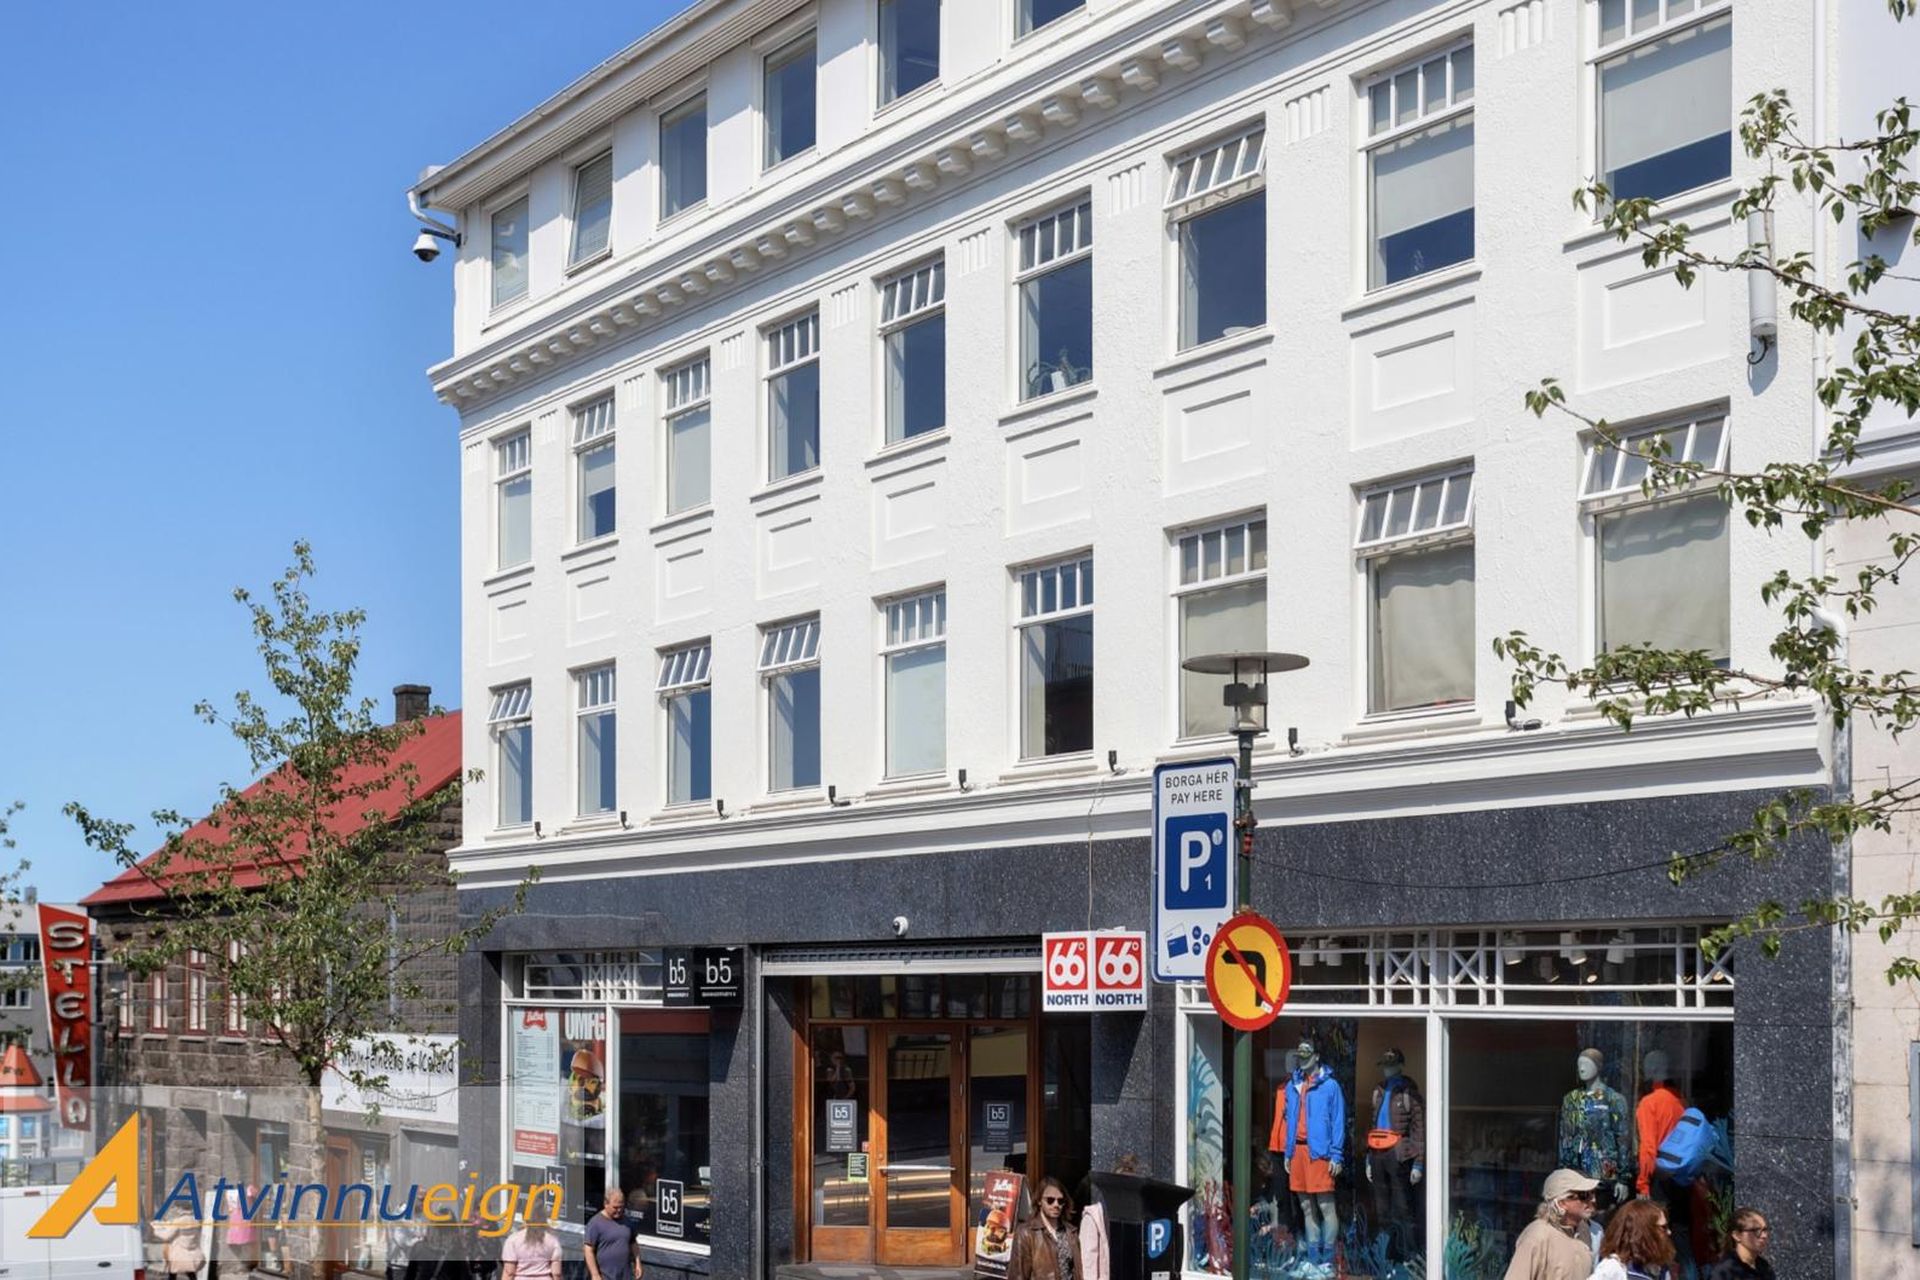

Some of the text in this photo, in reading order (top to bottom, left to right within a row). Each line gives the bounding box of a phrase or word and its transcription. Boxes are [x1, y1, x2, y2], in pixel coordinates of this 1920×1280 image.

[1165, 770, 1229, 789] BORGA HÉR
[1171, 788, 1223, 805] PAY HERE
[1180, 830, 1212, 892] P 1
[669, 958, 686, 984] b5
[706, 957, 732, 984] b5
[1046, 994, 1089, 1006] NORTH
[1095, 993, 1143, 1005] NORTH
[47, 919, 87, 1125] STELLA
[834, 1106, 848, 1119] b5
[991, 1107, 1005, 1119] b5
[661, 1188, 678, 1214] b5
[1151, 1223, 1165, 1251] P
